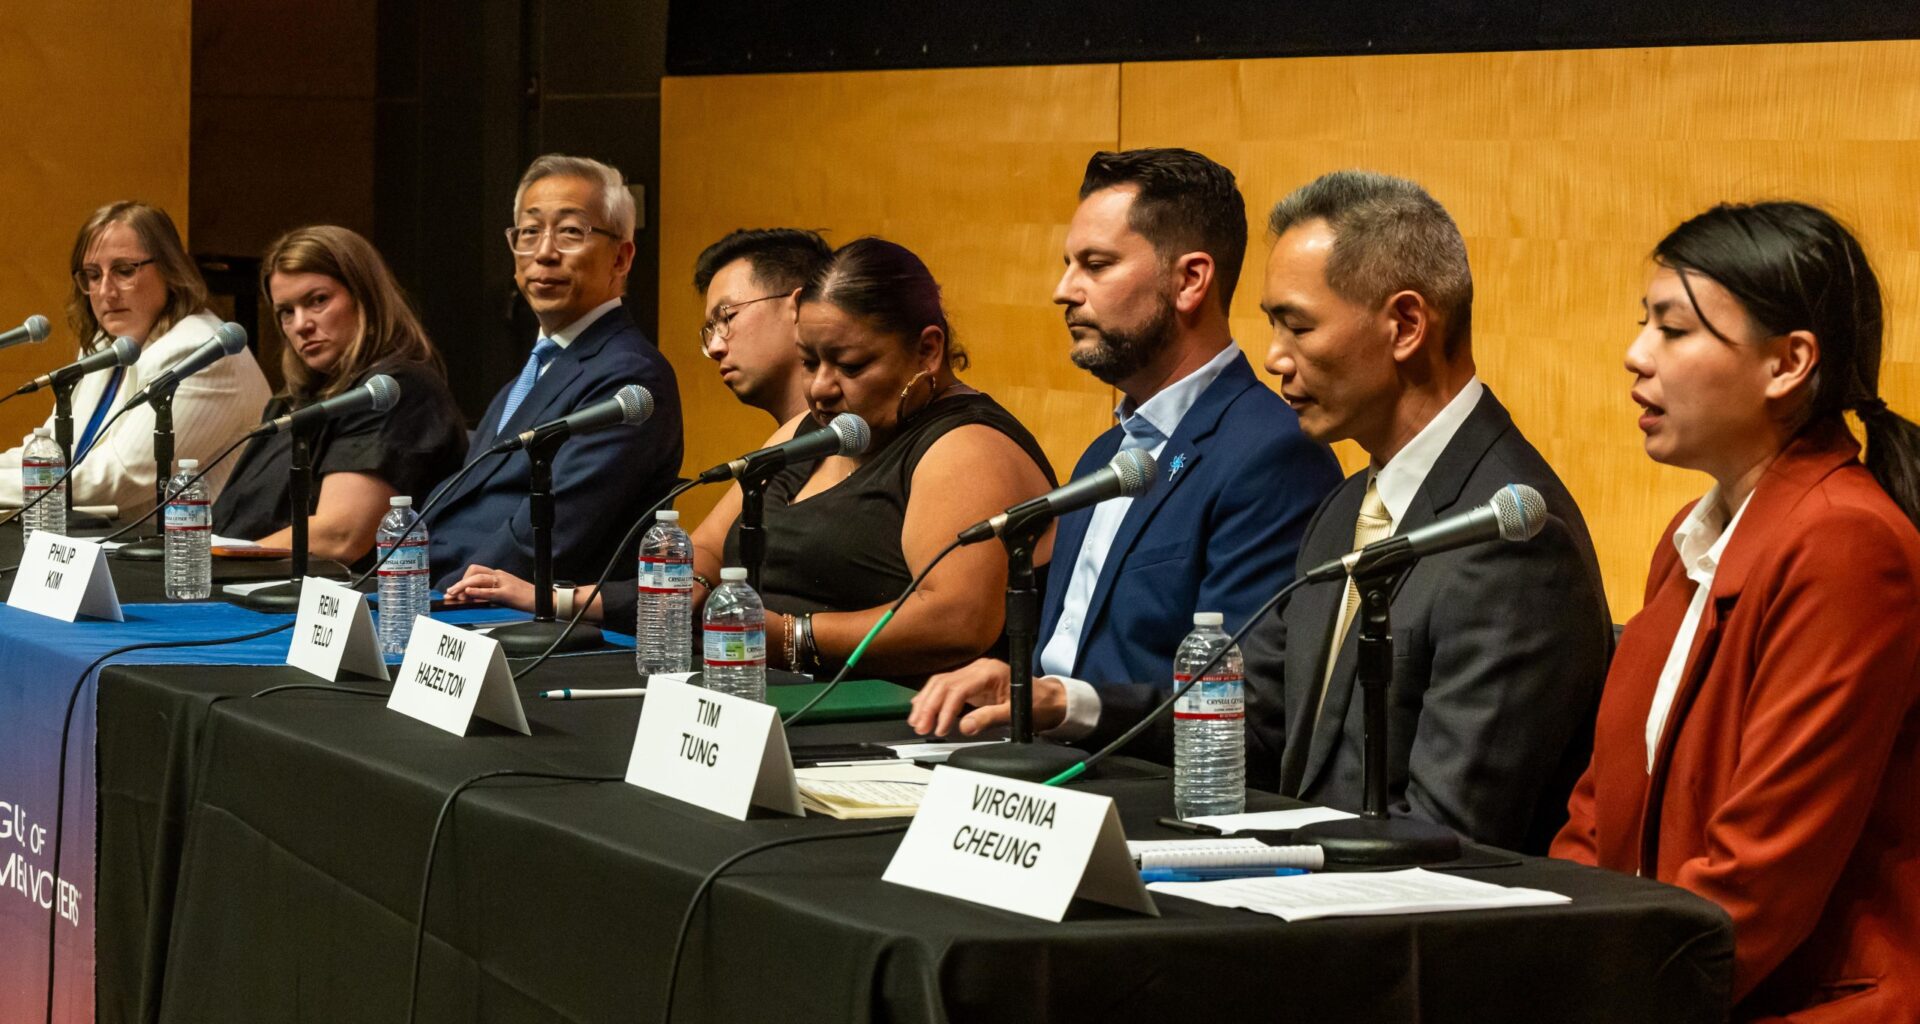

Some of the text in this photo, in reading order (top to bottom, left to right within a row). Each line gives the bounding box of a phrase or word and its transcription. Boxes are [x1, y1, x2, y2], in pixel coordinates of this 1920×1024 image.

[48, 543, 76, 564] PHILIP
[45, 570, 63, 590] KIM
[318, 594, 340, 619] REINA
[312, 624, 333, 648] TELLO
[437, 634, 466, 662] RYAN
[415, 661, 466, 699] HAZELTON
[697, 698, 722, 729] TIM
[680, 732, 719, 768] TUNG
[971, 784, 1057, 830] VIRGINIA
[30, 823, 47, 856] OF
[953, 825, 1041, 869] CHEUNG
[29, 864, 79, 927] VOTERS
